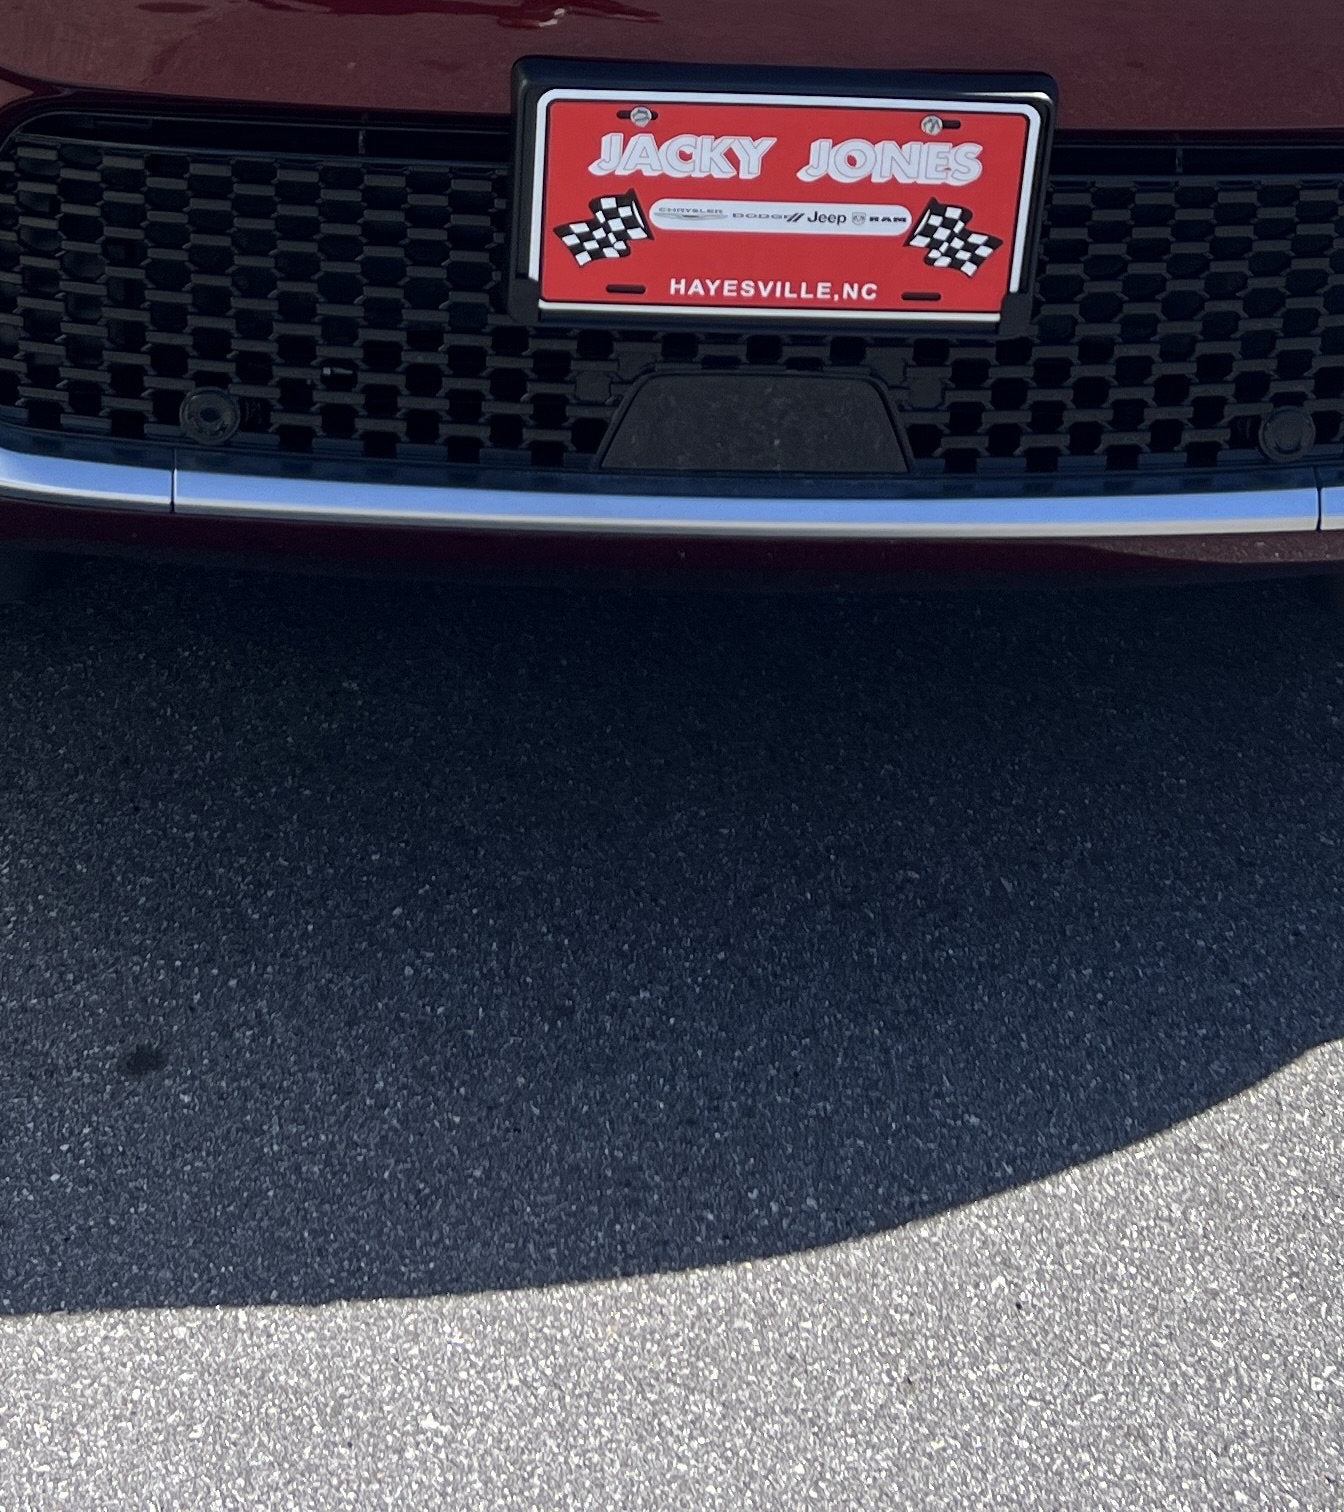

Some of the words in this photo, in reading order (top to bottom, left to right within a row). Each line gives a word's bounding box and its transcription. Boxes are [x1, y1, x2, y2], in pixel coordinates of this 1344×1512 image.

[588, 133, 776, 179] JACKY
[796, 139, 983, 187] JONES
[658, 206, 724, 214] CHRYSLER
[807, 210, 847, 226] Jeep
[869, 215, 907, 224] RAM
[669, 278, 878, 302] HAYESVILLE,NC
